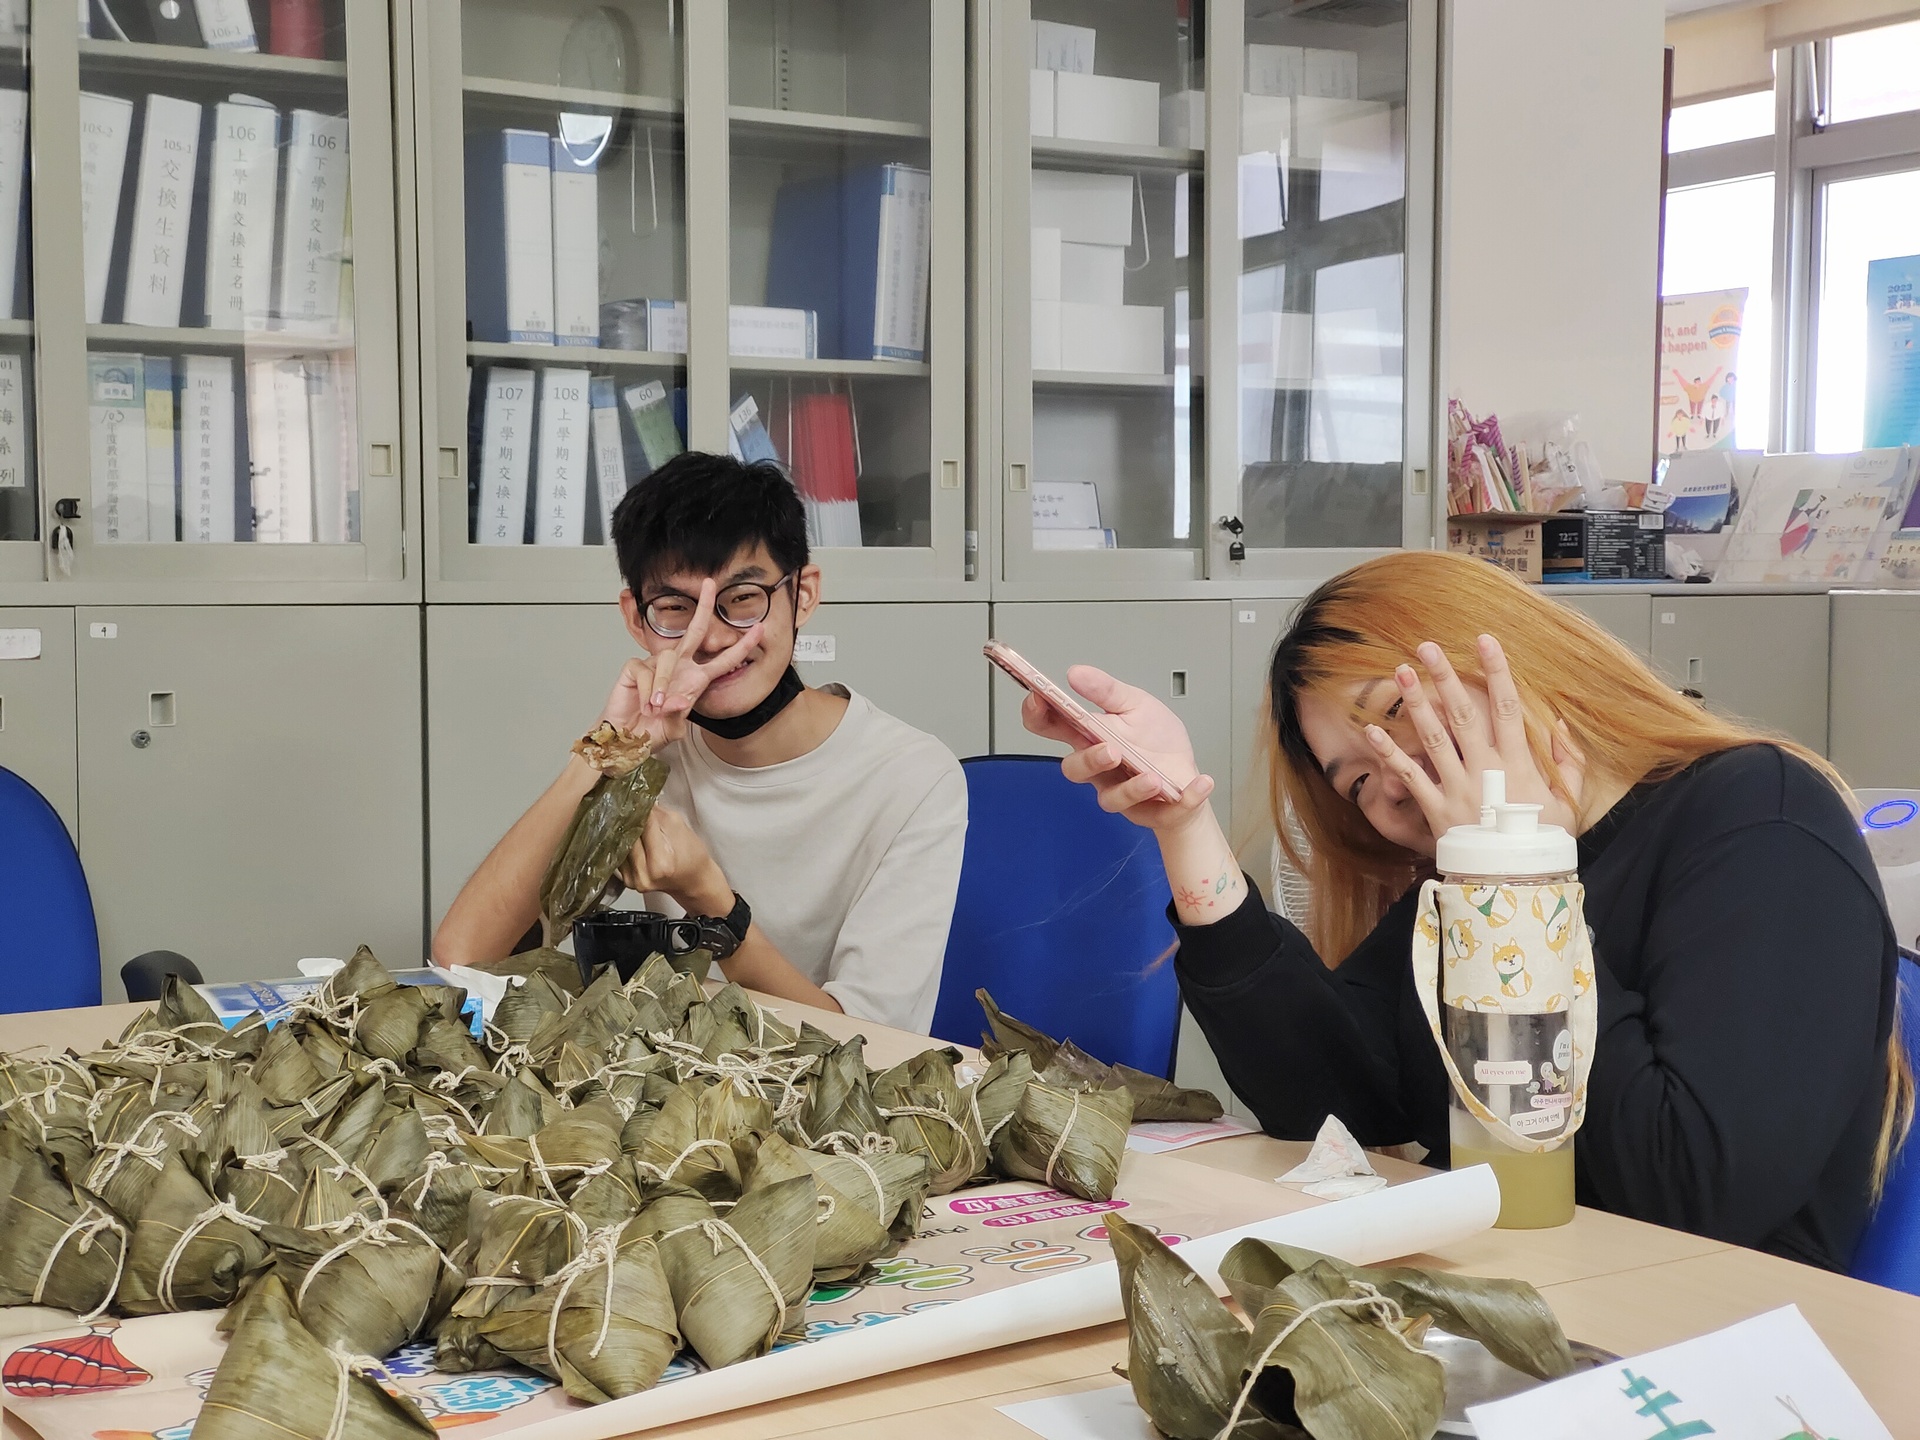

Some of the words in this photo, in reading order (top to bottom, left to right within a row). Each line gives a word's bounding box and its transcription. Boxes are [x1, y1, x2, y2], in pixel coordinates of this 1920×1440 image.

[227, 125, 257, 142] 106
[308, 132, 337, 150] 106
[163, 138, 193, 154] 105-1
[148, 158, 182, 296] 交換生資料
[228, 147, 249, 312] 上學期交換生名冊
[1677, 323, 1697, 336] and
[1668, 340, 1707, 355] happen
[197, 379, 213, 388] 104
[496, 386, 524, 401] 107
[553, 386, 580, 401] 108
[639, 387, 653, 401] 60
[737, 406, 752, 424] 136
[494, 407, 516, 538] 下學期交換生名
[551, 407, 572, 538] 上學期交換生名
[794, 639, 834, 656] 印紙
[1490, 1069, 1504, 1077] eyes
